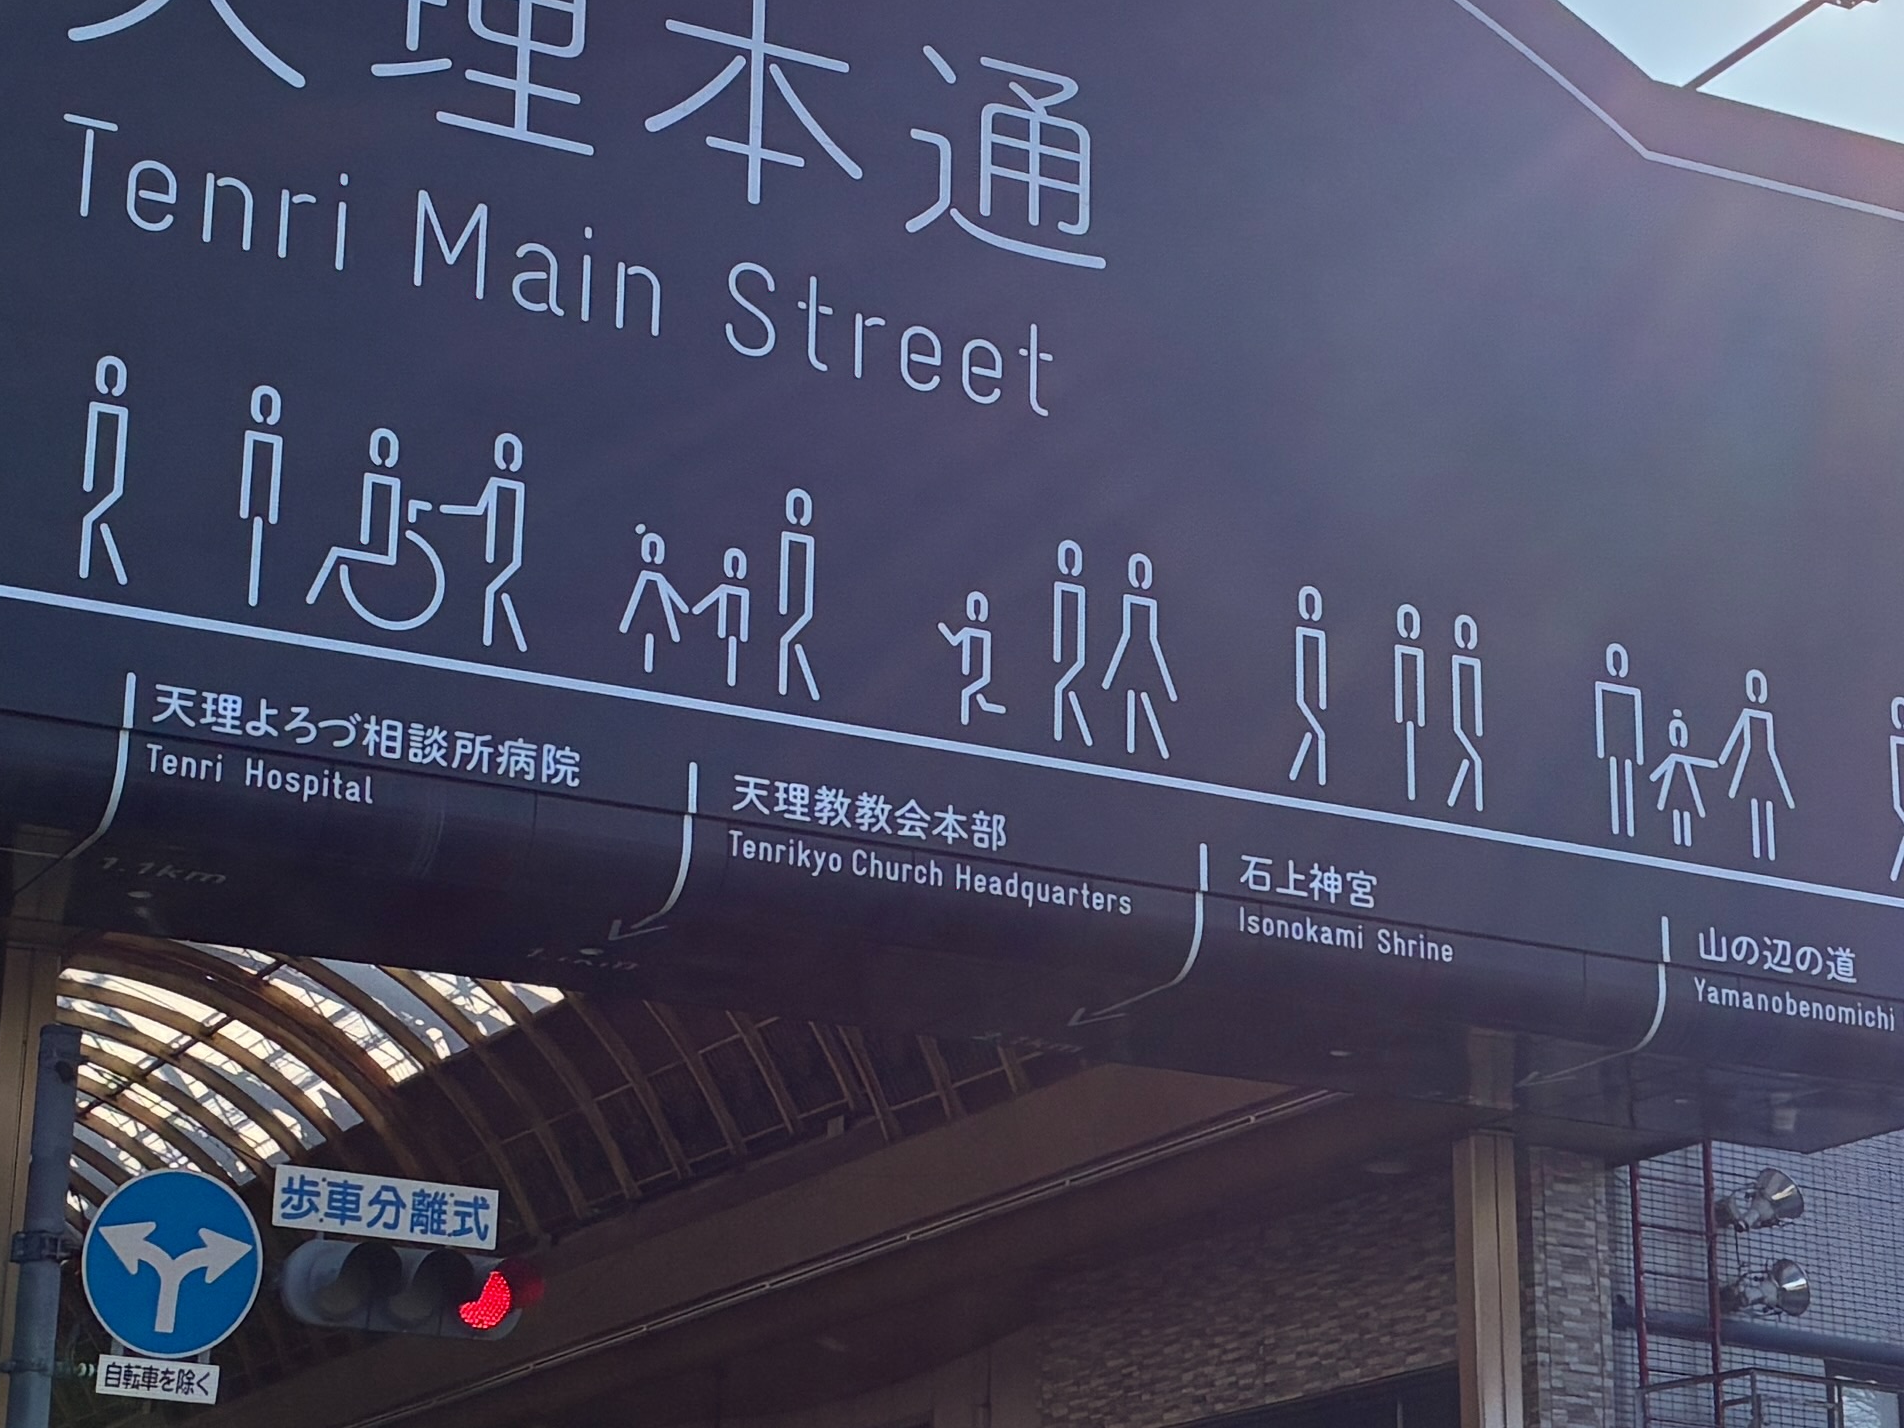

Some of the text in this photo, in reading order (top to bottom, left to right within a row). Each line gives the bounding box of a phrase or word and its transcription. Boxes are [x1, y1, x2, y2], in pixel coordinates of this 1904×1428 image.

[63, 112, 1056, 418] Tenri Main Street
[151, 682, 582, 788] 天理よろづ相談所病院
[146, 743, 374, 804] Tenri Hospital
[731, 774, 1008, 852] 天理教教会本部
[101, 856, 227, 884] 1.1km
[728, 829, 1132, 916] Tenrikyo Church Headquarters
[1238, 853, 1378, 910] 石上神宮
[1238, 905, 1454, 964] Isonokami Shrine
[1698, 925, 1858, 986] 山の辺の道
[1695, 977, 1895, 1034] Yamanobenomichi
[280, 1173, 491, 1243] 歩車分離式
[104, 1361, 211, 1397] 自転車を除く
